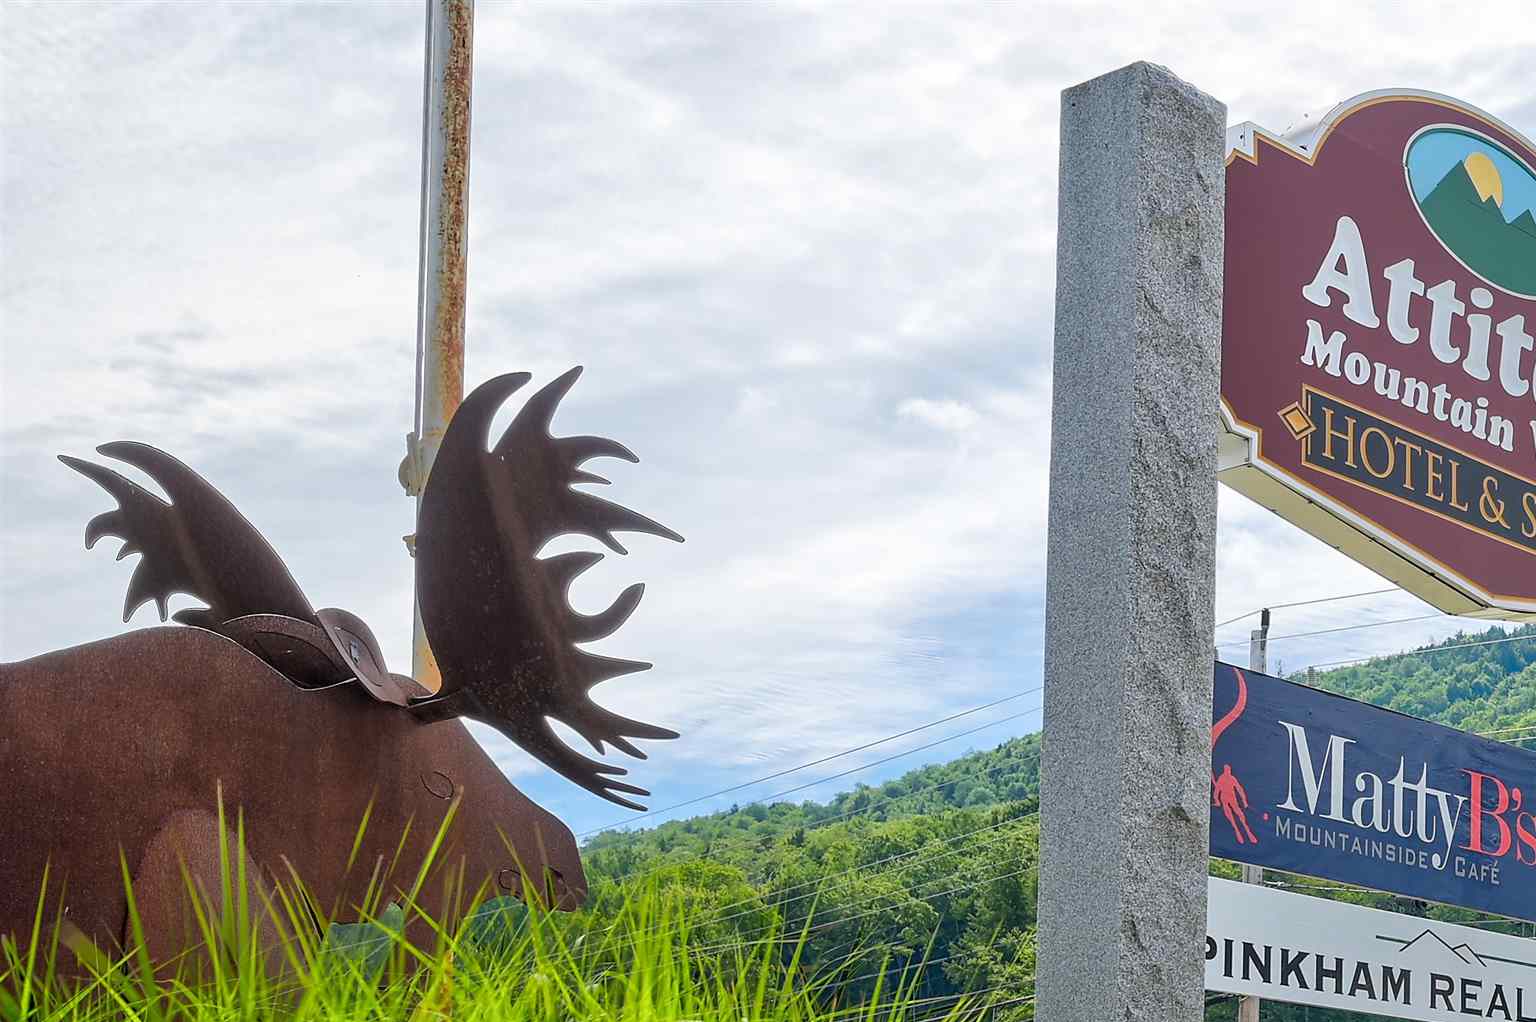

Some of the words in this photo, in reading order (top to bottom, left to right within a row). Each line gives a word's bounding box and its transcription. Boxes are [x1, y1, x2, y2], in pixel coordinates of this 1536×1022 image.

[1301, 319, 1514, 452] Mountain
[1321, 406, 1469, 513] HOTEL
[1479, 474, 1509, 528] &
[1275, 815, 1428, 870] MOUNTAINSIDE
[1454, 856, 1500, 885] CAFÉ
